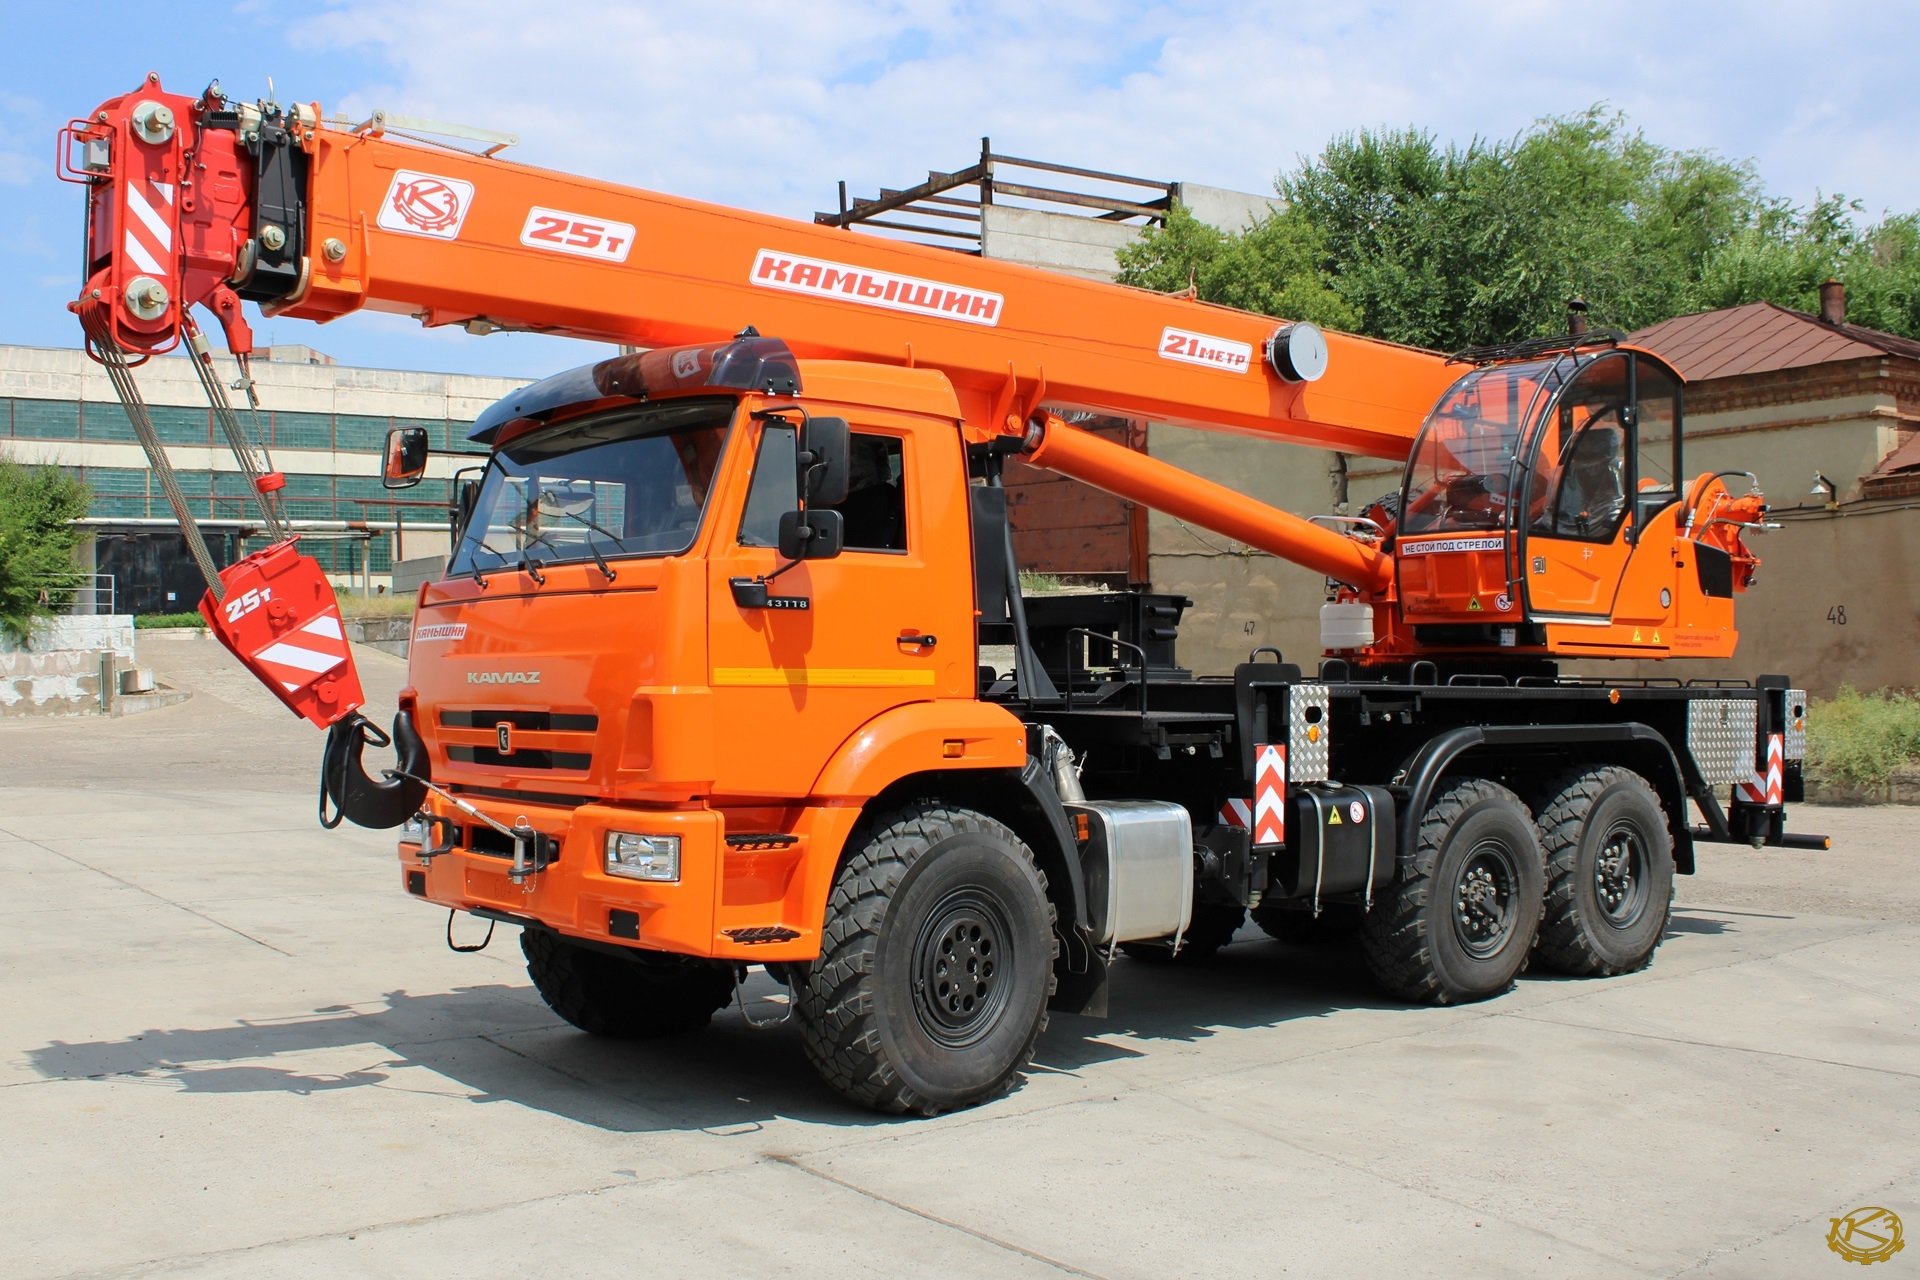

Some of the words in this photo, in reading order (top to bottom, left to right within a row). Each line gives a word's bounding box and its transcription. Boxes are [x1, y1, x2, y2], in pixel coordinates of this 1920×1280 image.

[757, 256, 998, 320] КАМЫШИН
[1416, 541, 1436, 552] СТОЙ
[1437, 542, 1455, 551] ПОД
[1456, 538, 1502, 550] СТРЕЛОЙ
[767, 599, 807, 608] 43118
[1826, 605, 1847, 625] 48
[416, 625, 465, 639] КАМЫШИН
[1243, 621, 1255, 636] 47
[467, 671, 540, 684] KAMAZ
